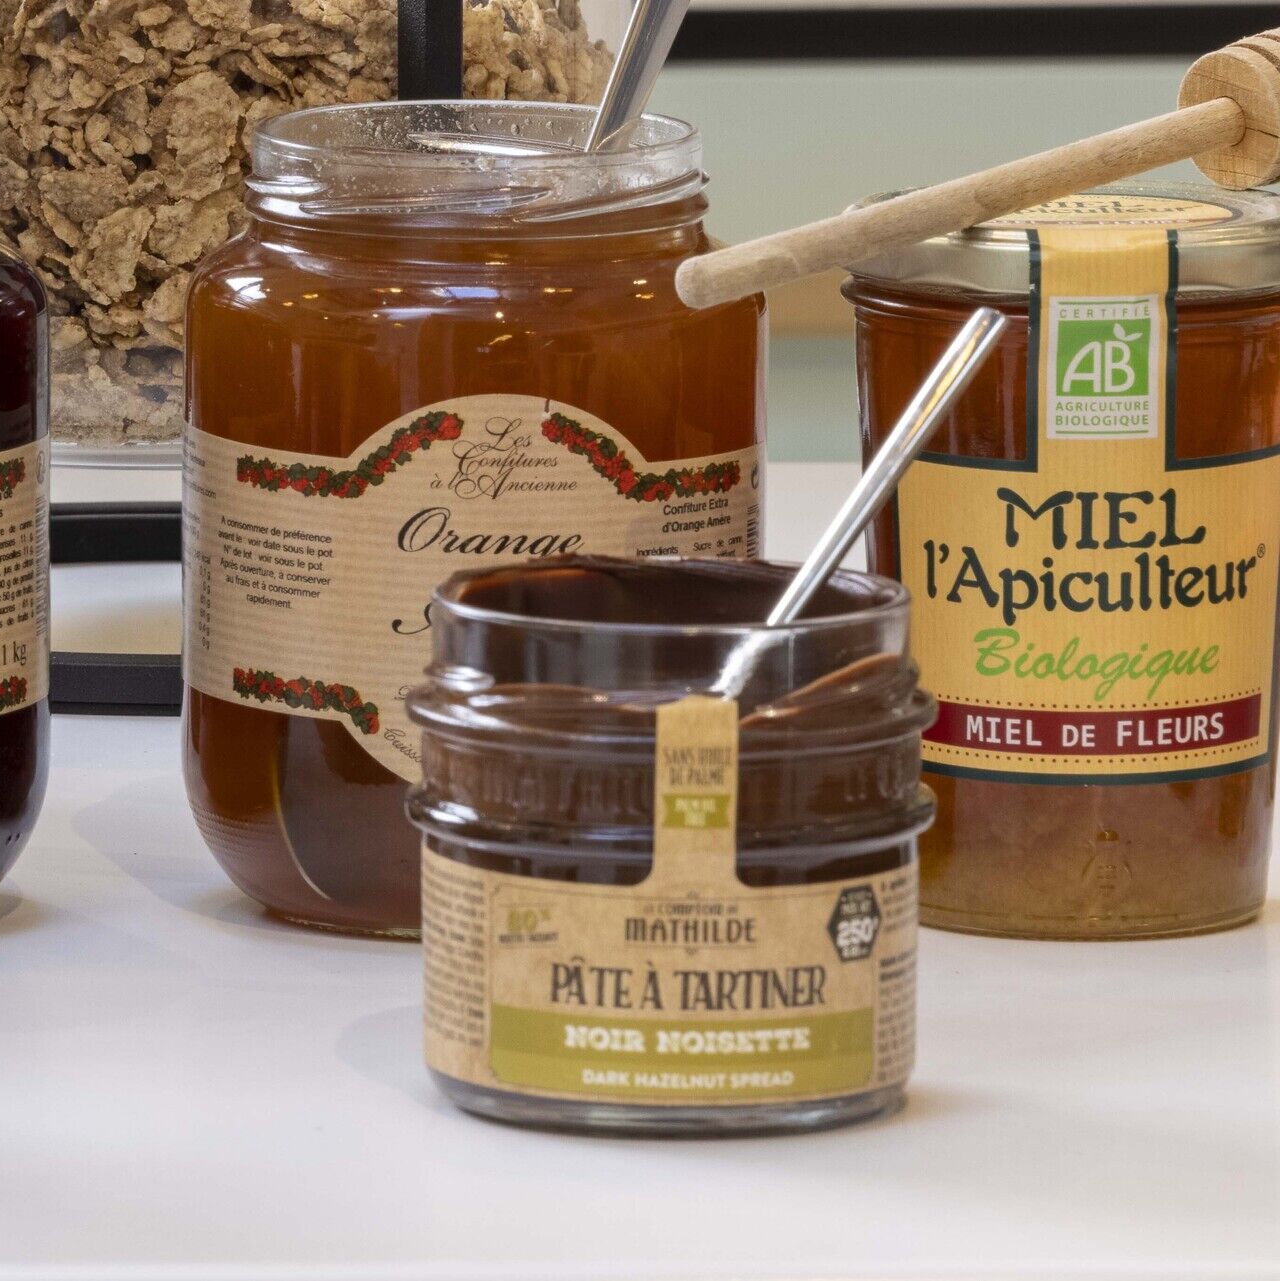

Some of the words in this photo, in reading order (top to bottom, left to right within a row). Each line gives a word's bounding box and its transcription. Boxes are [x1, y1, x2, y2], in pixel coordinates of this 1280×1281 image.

[1062, 340, 1135, 392] AB
[1055, 401, 1149, 412] AGRICULTURE
[485, 416, 532, 451] Les
[1055, 415, 1149, 426] BIOLOGIQUE
[452, 440, 558, 476] Confitures
[430, 473, 442, 490] à
[663, 501, 707, 516] Confiture
[709, 498, 728, 510] Extra
[997, 487, 1206, 550] MIEL
[227, 519, 269, 535] consommer
[270, 526, 282, 537] de
[283, 529, 332, 544] préférence
[398, 507, 585, 557] Orange
[662, 519, 705, 533] d'Orange
[707, 515, 731, 528] Amère
[218, 530, 235, 542] avant
[247, 538, 261, 547] voir
[263, 539, 281, 551] date
[283, 544, 304, 555] sous
[306, 545, 315, 556] le
[233, 547, 242, 558] de
[243, 550, 252, 560] lot
[258, 554, 272, 563] voir
[274, 556, 295, 567] sous
[297, 558, 305, 568] le
[220, 557, 238, 571] Après
[278, 570, 284, 579] à
[286, 572, 331, 586] conserver
[226, 574, 234, 583] au
[235, 575, 251, 588] frais
[252, 580, 260, 590] et
[261, 581, 267, 591] à
[268, 583, 321, 599] consommer
[2, 644, 7, 665] 1
[13, 640, 26, 666] kg
[974, 627, 1220, 702] Biologique
[966, 714, 1042, 747] MIEL
[1062, 724, 1096, 748] DE
[1117, 712, 1224, 747] FLEURS
[385, 728, 422, 763] Cuiss
[626, 917, 757, 942] MATHILDE
[550, 954, 633, 1009] PÂTE
[641, 960, 664, 1010] À
[673, 963, 826, 1010] TARTINER
[564, 1023, 645, 1052] NOIR
[656, 1026, 811, 1054] NOISETTE
[582, 1068, 630, 1086] DARK
[635, 1071, 726, 1089] HAZELNUT
[730, 1070, 794, 1088] SPREAD
